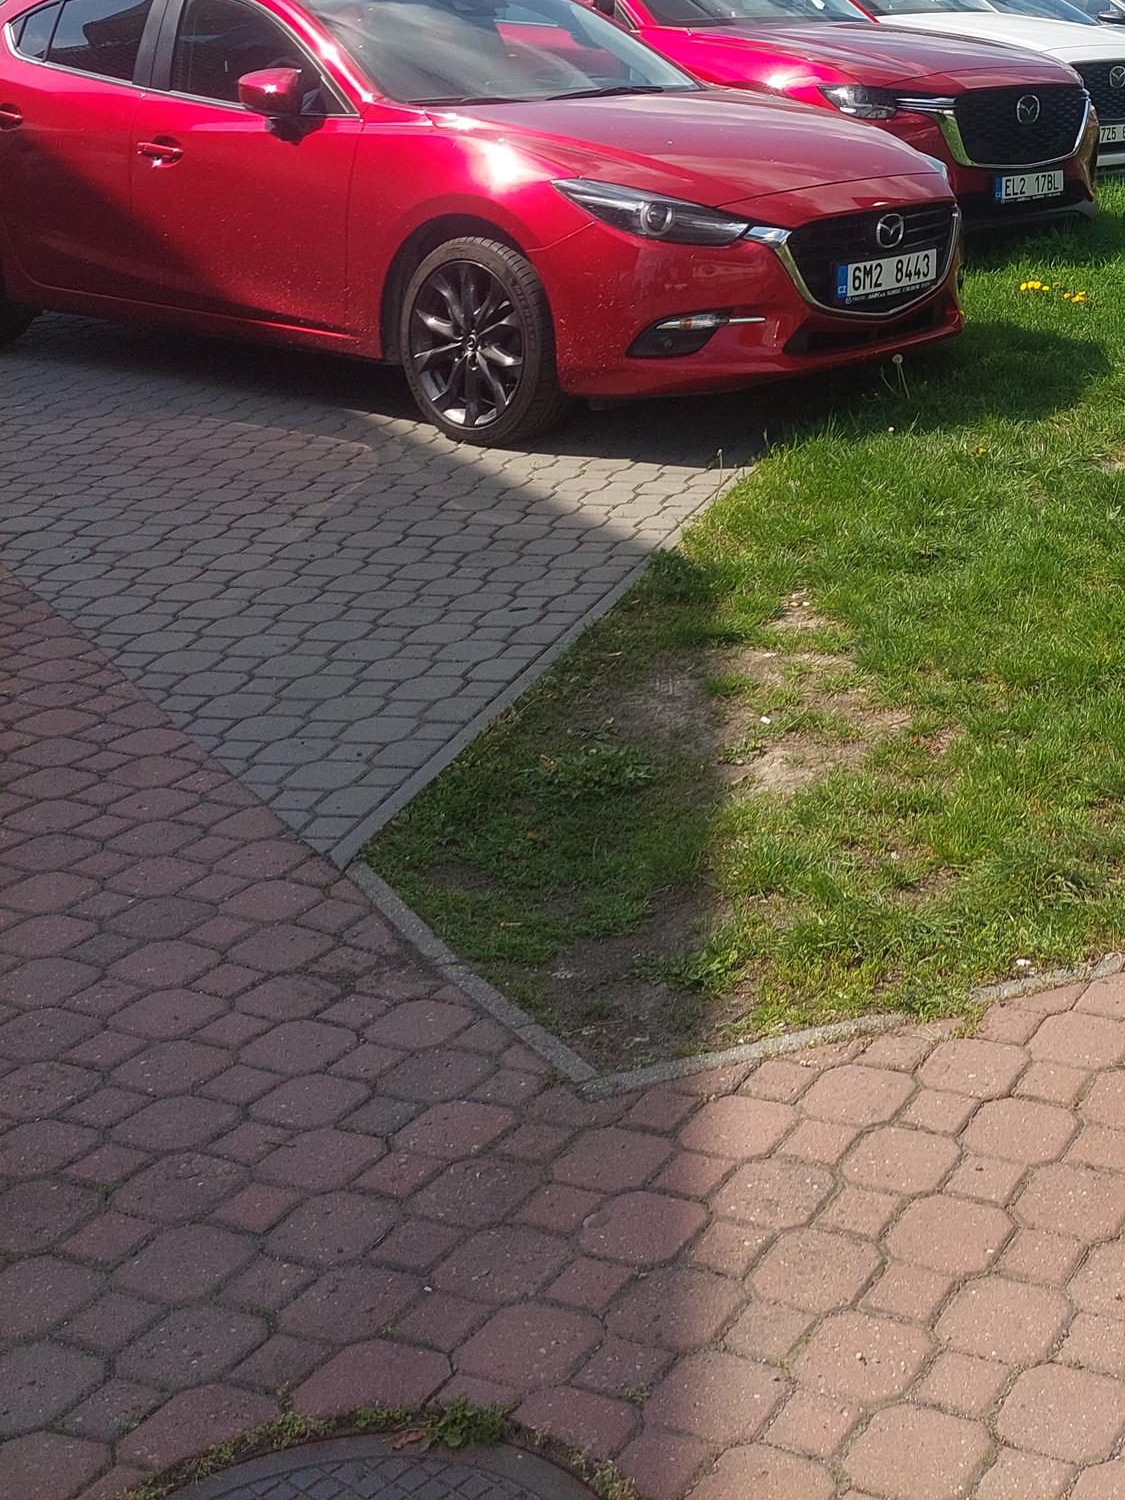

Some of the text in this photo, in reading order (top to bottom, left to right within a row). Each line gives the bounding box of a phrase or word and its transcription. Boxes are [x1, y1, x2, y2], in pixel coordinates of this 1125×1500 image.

[1100, 127, 1117, 142] 7Z5
[1004, 172, 1059, 197] EL2 17BL
[852, 253, 931, 291] 6M2 8443
[837, 285, 847, 294] CZ
